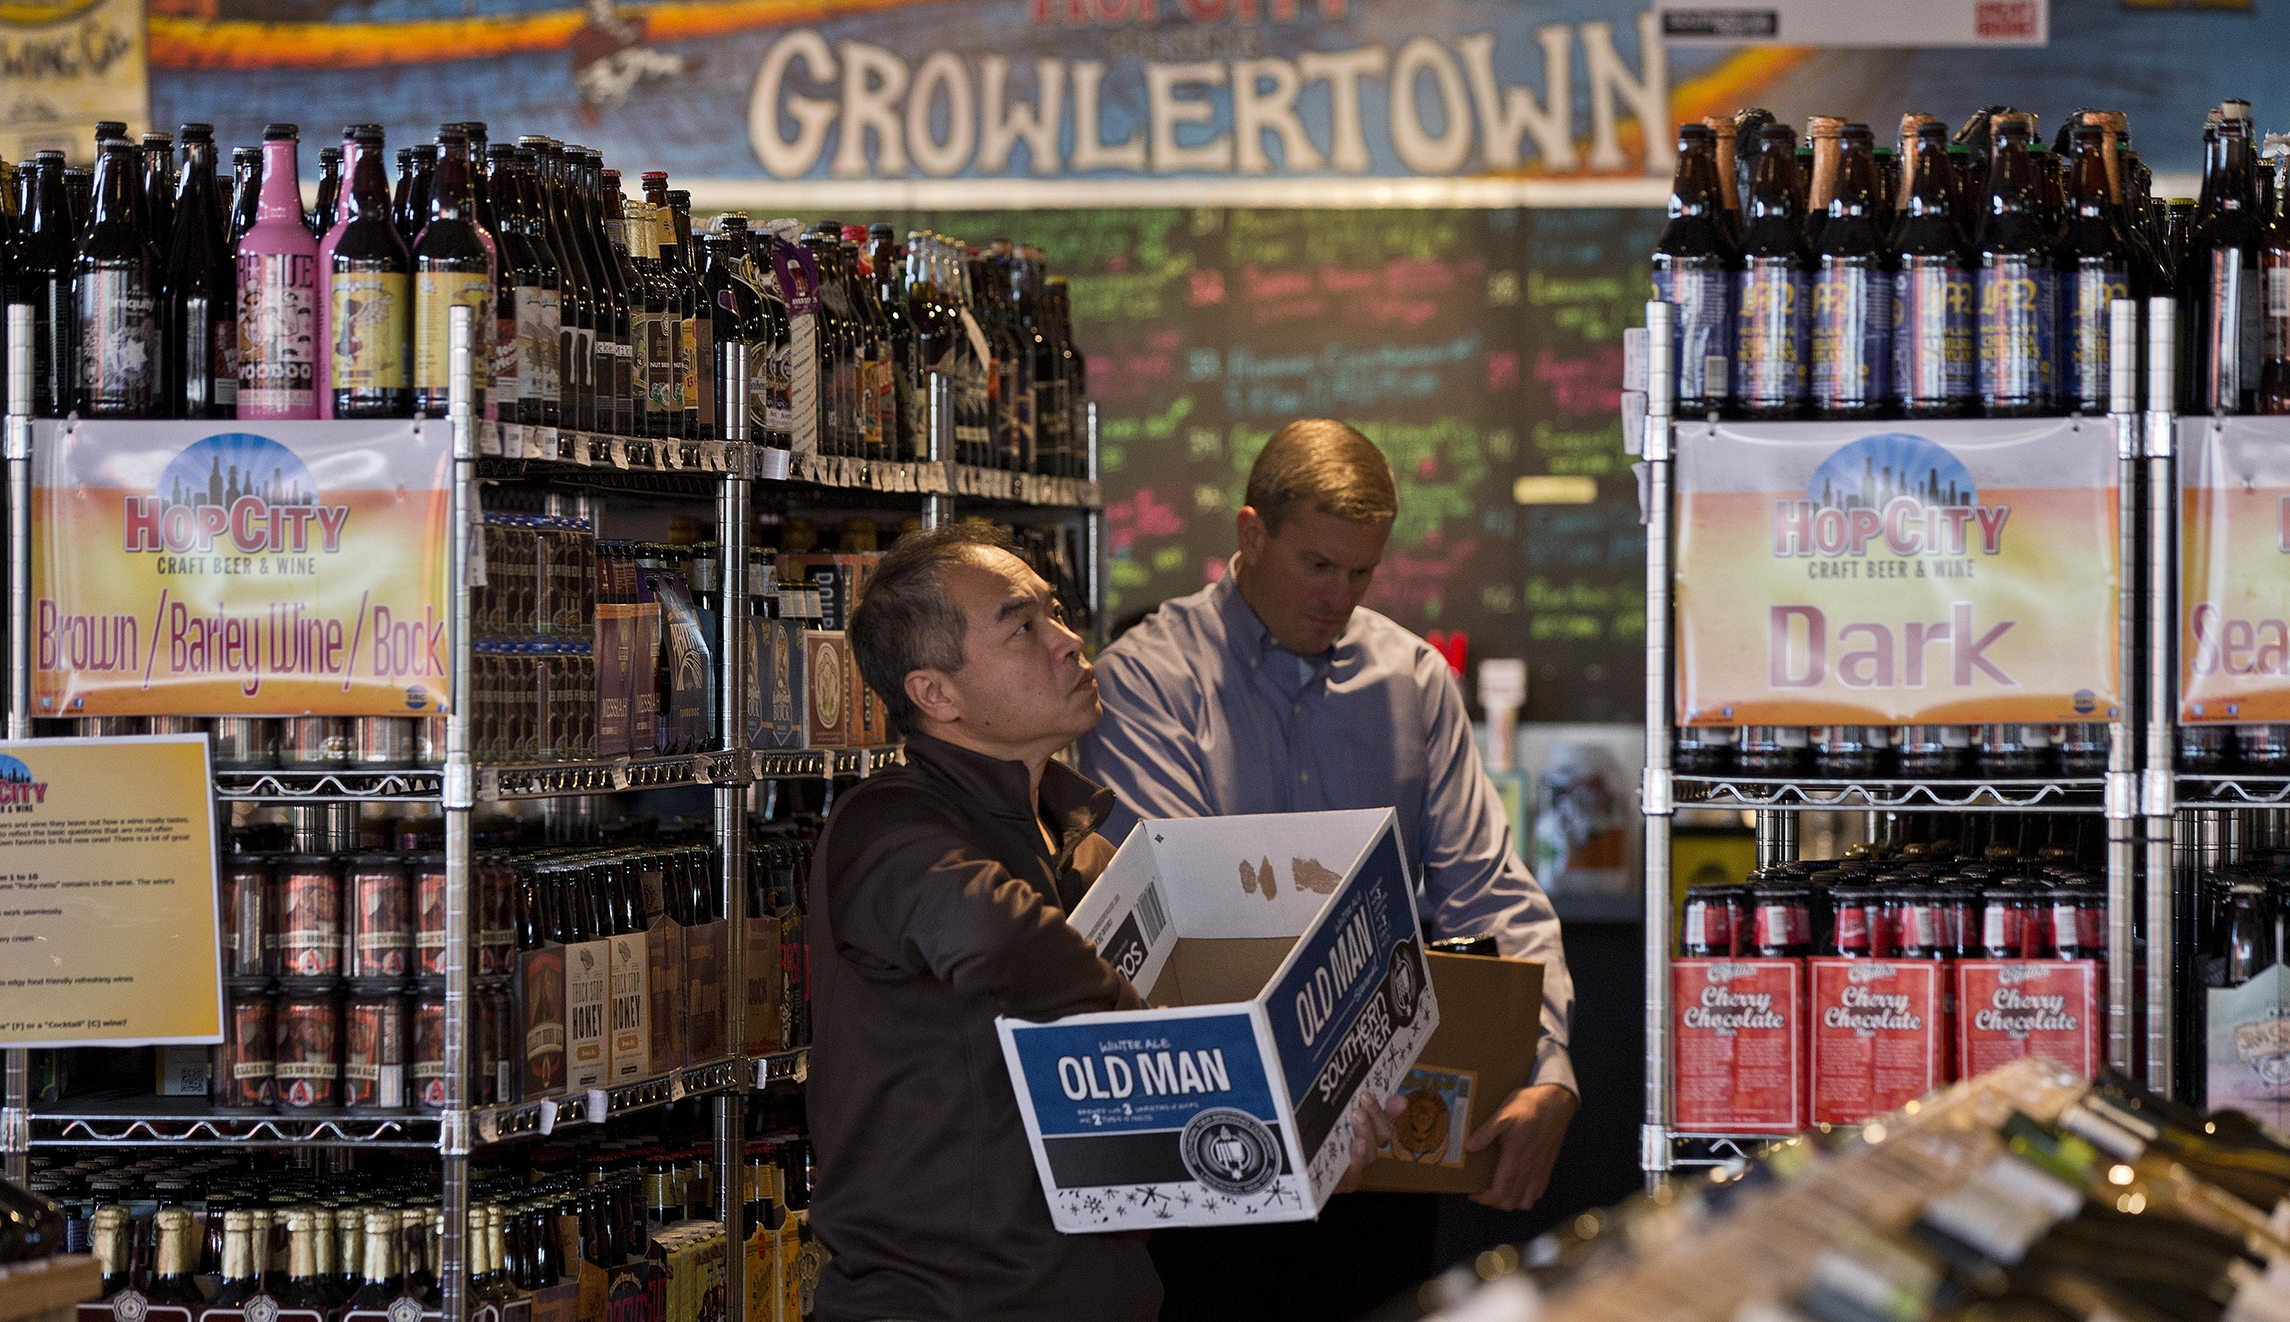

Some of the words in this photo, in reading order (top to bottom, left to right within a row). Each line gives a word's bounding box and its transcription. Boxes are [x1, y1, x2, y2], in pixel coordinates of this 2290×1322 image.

[749, 12, 1677, 178] GROWLERTOWN
[238, 363, 312, 379] VOODOO
[157, 557, 205, 575] CRAFT
[213, 557, 251, 575] BEER
[259, 557, 269, 574] &
[276, 557, 316, 575] WINE
[1808, 560, 1859, 579] CRAFT
[1867, 560, 1908, 578] BEER
[1914, 560, 1925, 578] &
[38, 599, 138, 672] Brown
[169, 601, 260, 697] Barley
[373, 604, 446, 678] Bock
[1767, 601, 2021, 689] Dark
[602, 697, 628, 718] MESSIAH
[635, 692, 661, 714] MESSIAH
[1296, 965, 1333, 1048] OLD
[1329, 904, 1373, 1000] MAN
[1701, 985, 1772, 1012] Cherry
[1841, 985, 1910, 1013] Cherry
[1992, 987, 2066, 1014] Cherry
[573, 1004, 603, 1040] HONEY
[613, 995, 640, 1030] HONEY
[1683, 1006, 1785, 1028] Chocolate
[1824, 1006, 1923, 1029] Chocolate
[1974, 1008, 2079, 1031] Chocolate
[1099, 1039, 1142, 1053] WINTER
[1145, 1037, 1171, 1049] ALE
[1319, 991, 1388, 1103] SOUTHERN
[1362, 1015, 1391, 1065] TIER
[1057, 1055, 1134, 1101] OLD
[1136, 1048, 1232, 1096] MAN
[1092, 1114, 1102, 1126] 2
